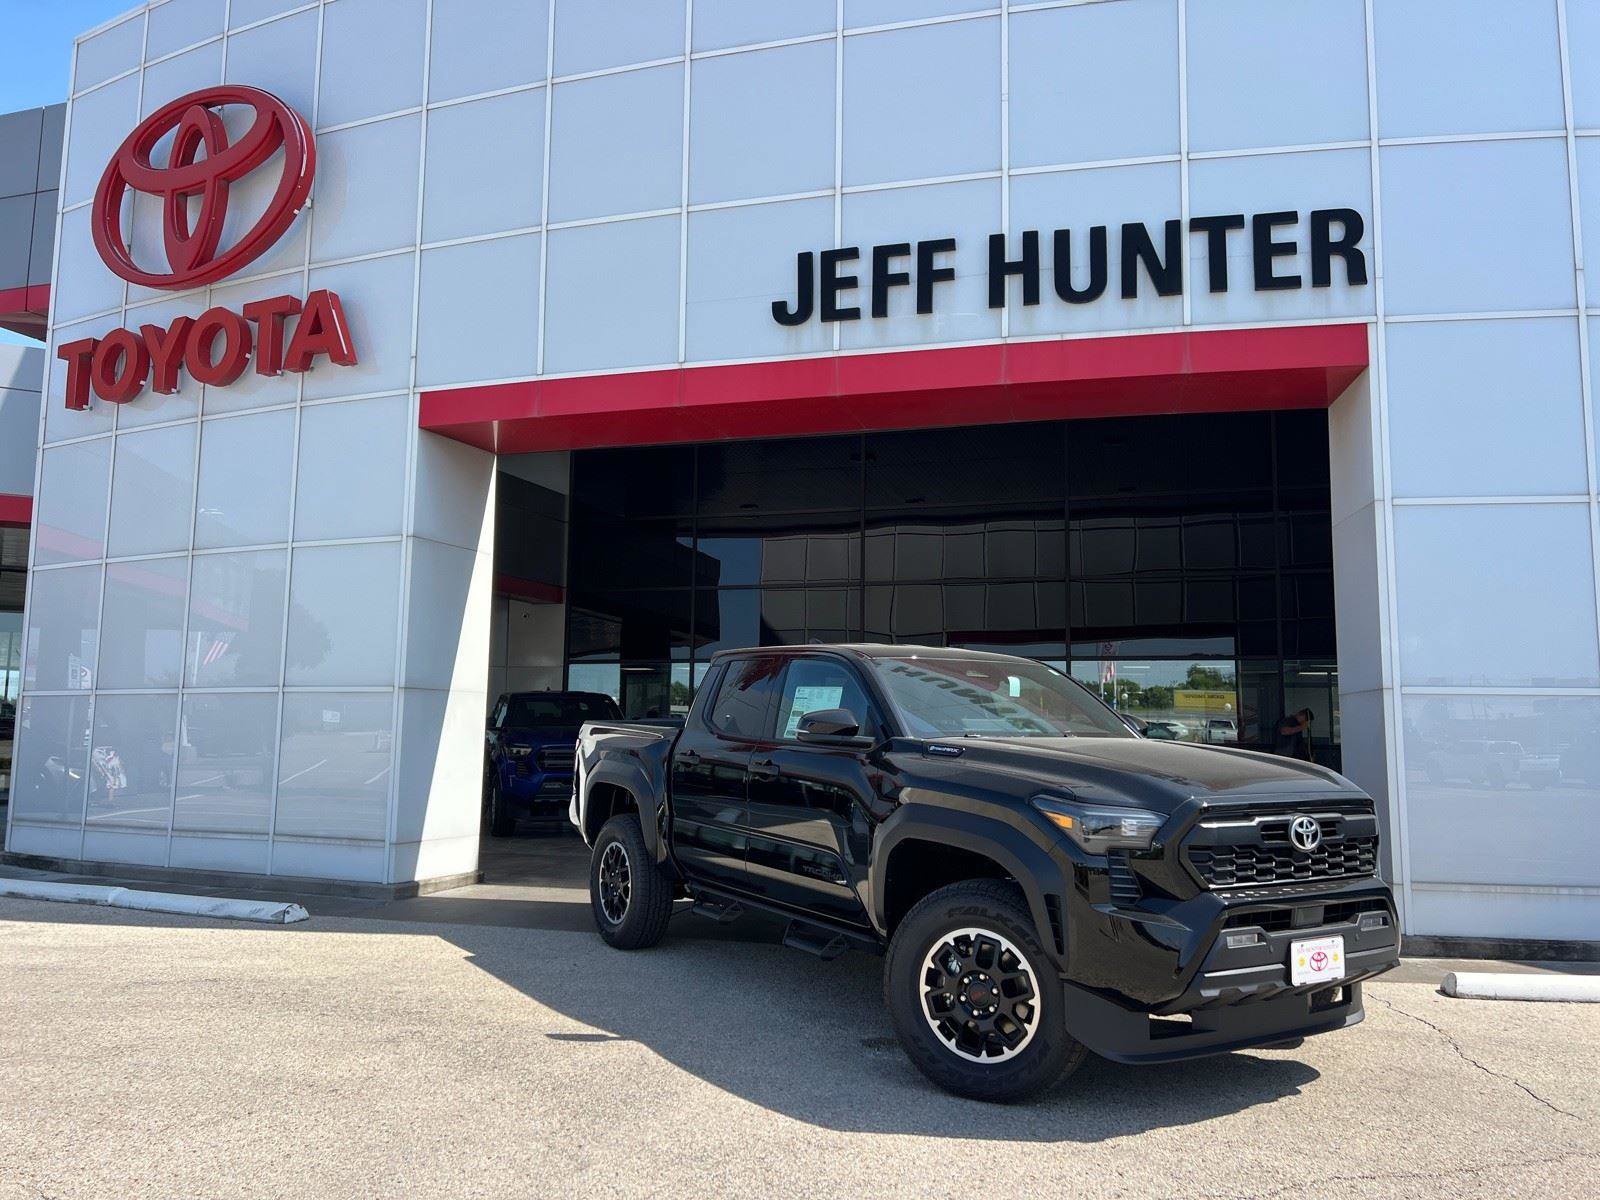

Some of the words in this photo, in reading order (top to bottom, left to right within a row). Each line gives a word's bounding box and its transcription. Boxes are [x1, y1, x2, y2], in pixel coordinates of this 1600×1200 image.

[771, 238, 957, 327] JEFF
[987, 207, 1368, 309] HUNTER
[57, 289, 358, 411] TOYOTA
